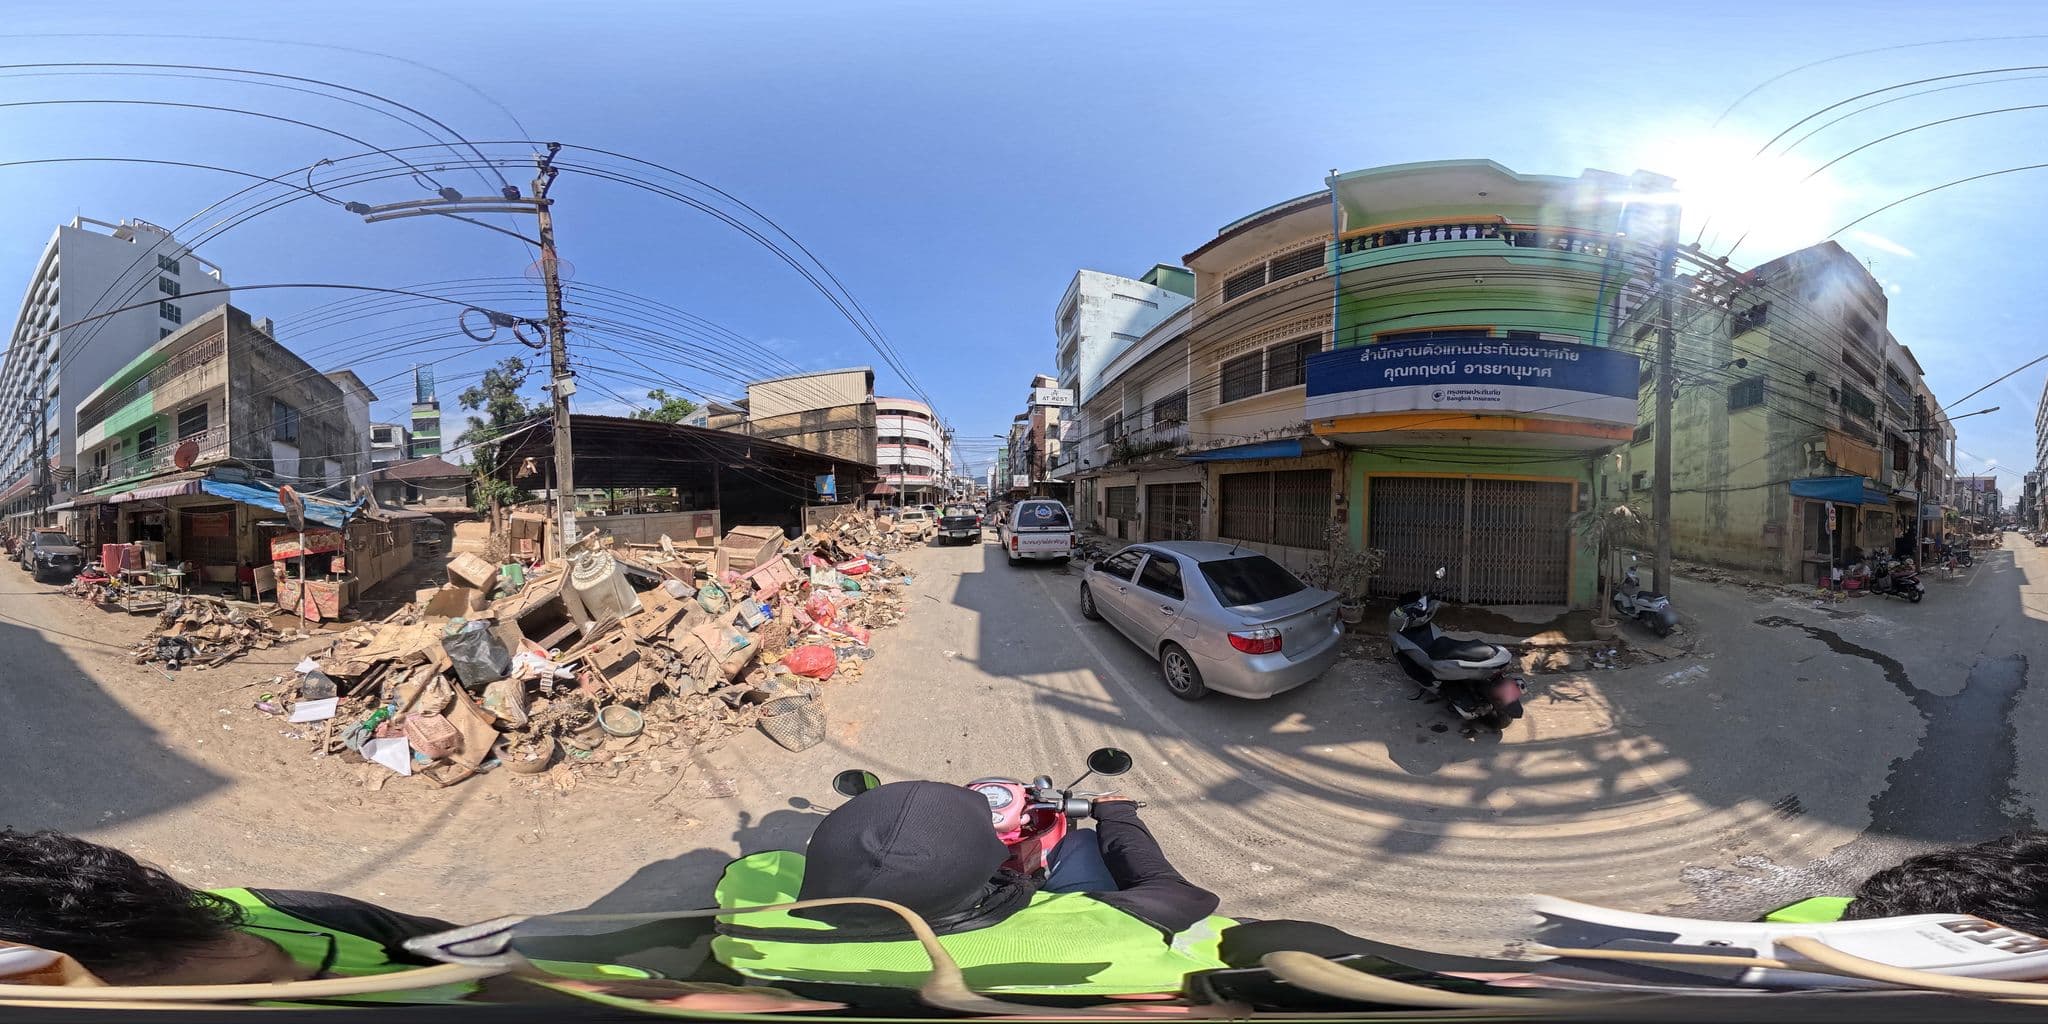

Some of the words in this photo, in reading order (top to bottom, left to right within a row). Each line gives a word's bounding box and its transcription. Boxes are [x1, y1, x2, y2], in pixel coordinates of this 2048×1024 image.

[1360, 343, 1580, 362] สำนักงานตัวแทนประกันวินาศภัย
[1384, 360, 1457, 382] คุณกฤษณ์
[1463, 363, 1552, 380] อารยานุมาศ
